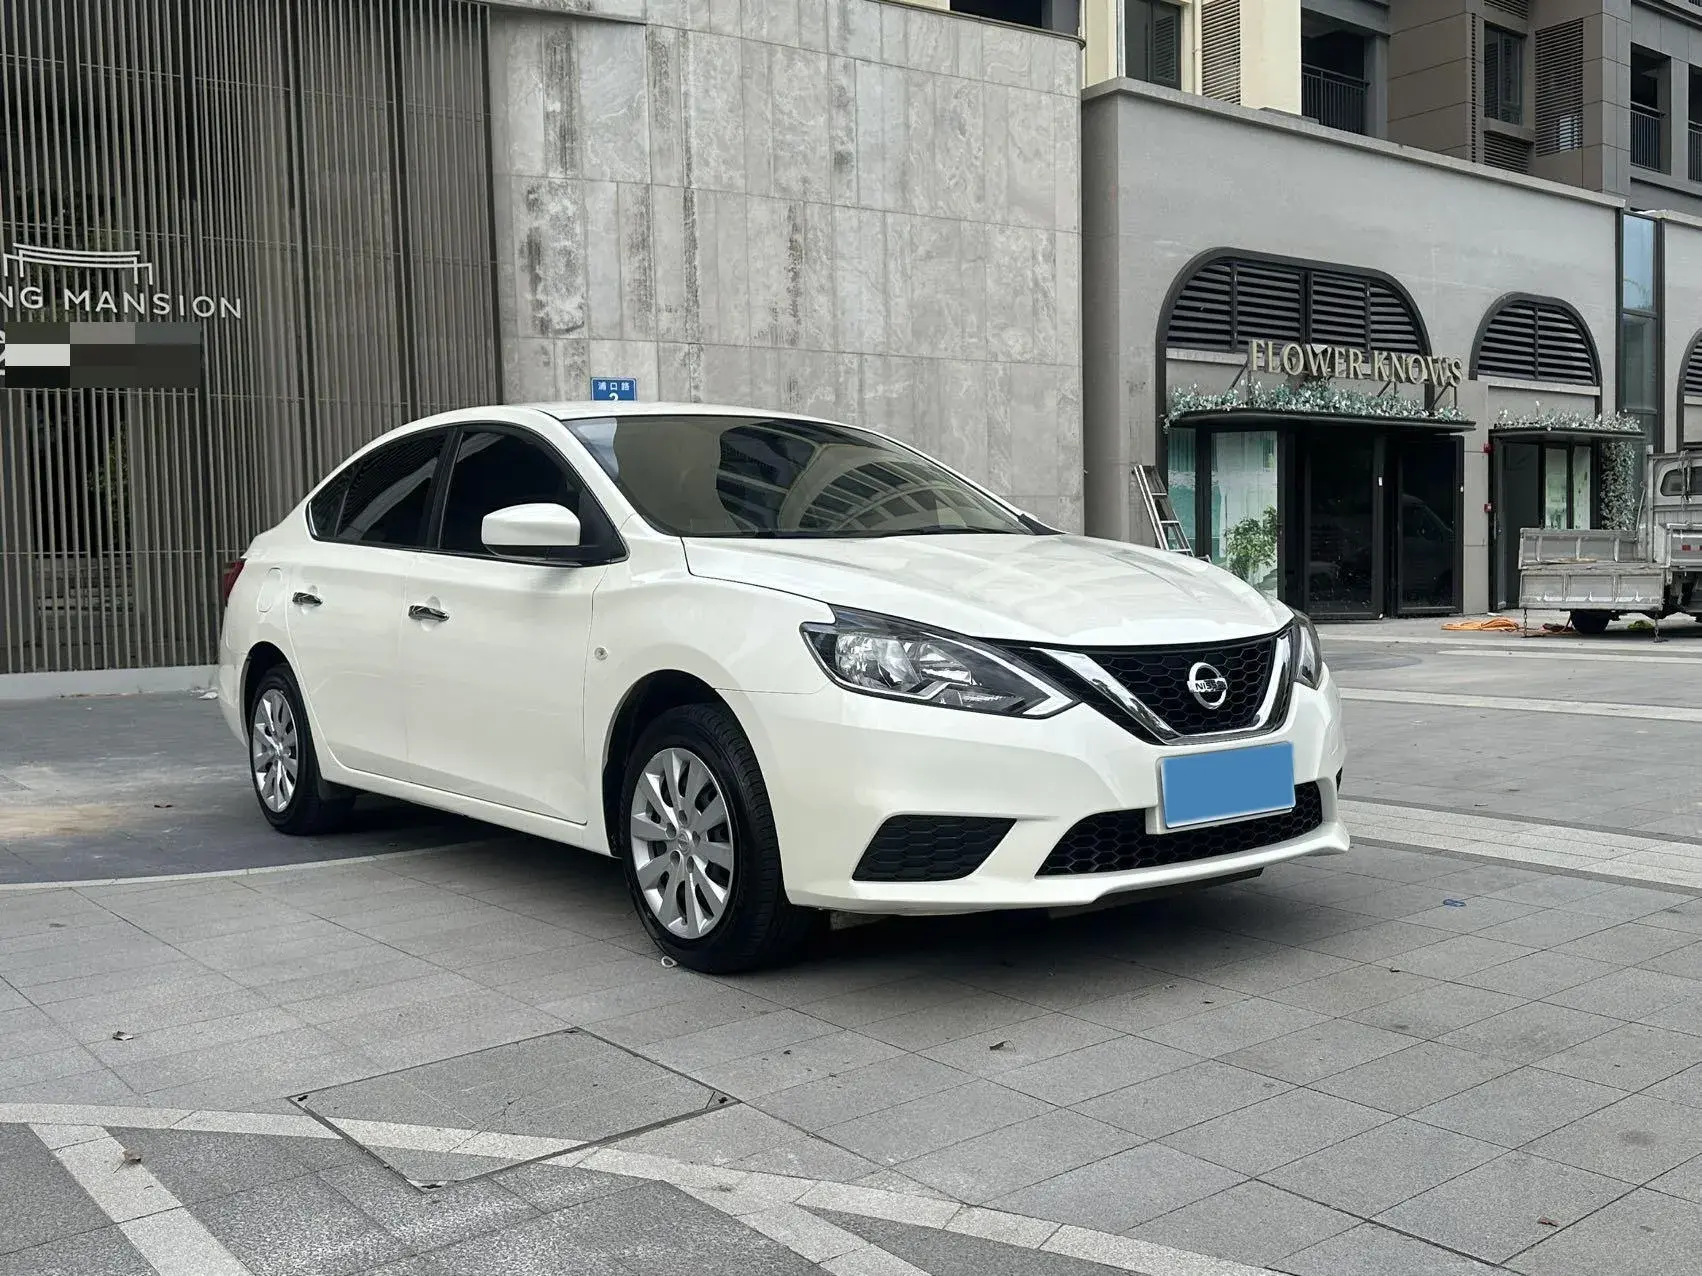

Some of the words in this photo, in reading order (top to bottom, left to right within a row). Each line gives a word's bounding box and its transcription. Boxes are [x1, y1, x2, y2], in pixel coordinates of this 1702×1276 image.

[64, 288, 241, 319] MANSION
[1252, 339, 1364, 380] FLOWER
[1372, 350, 1464, 387] KNOWS
